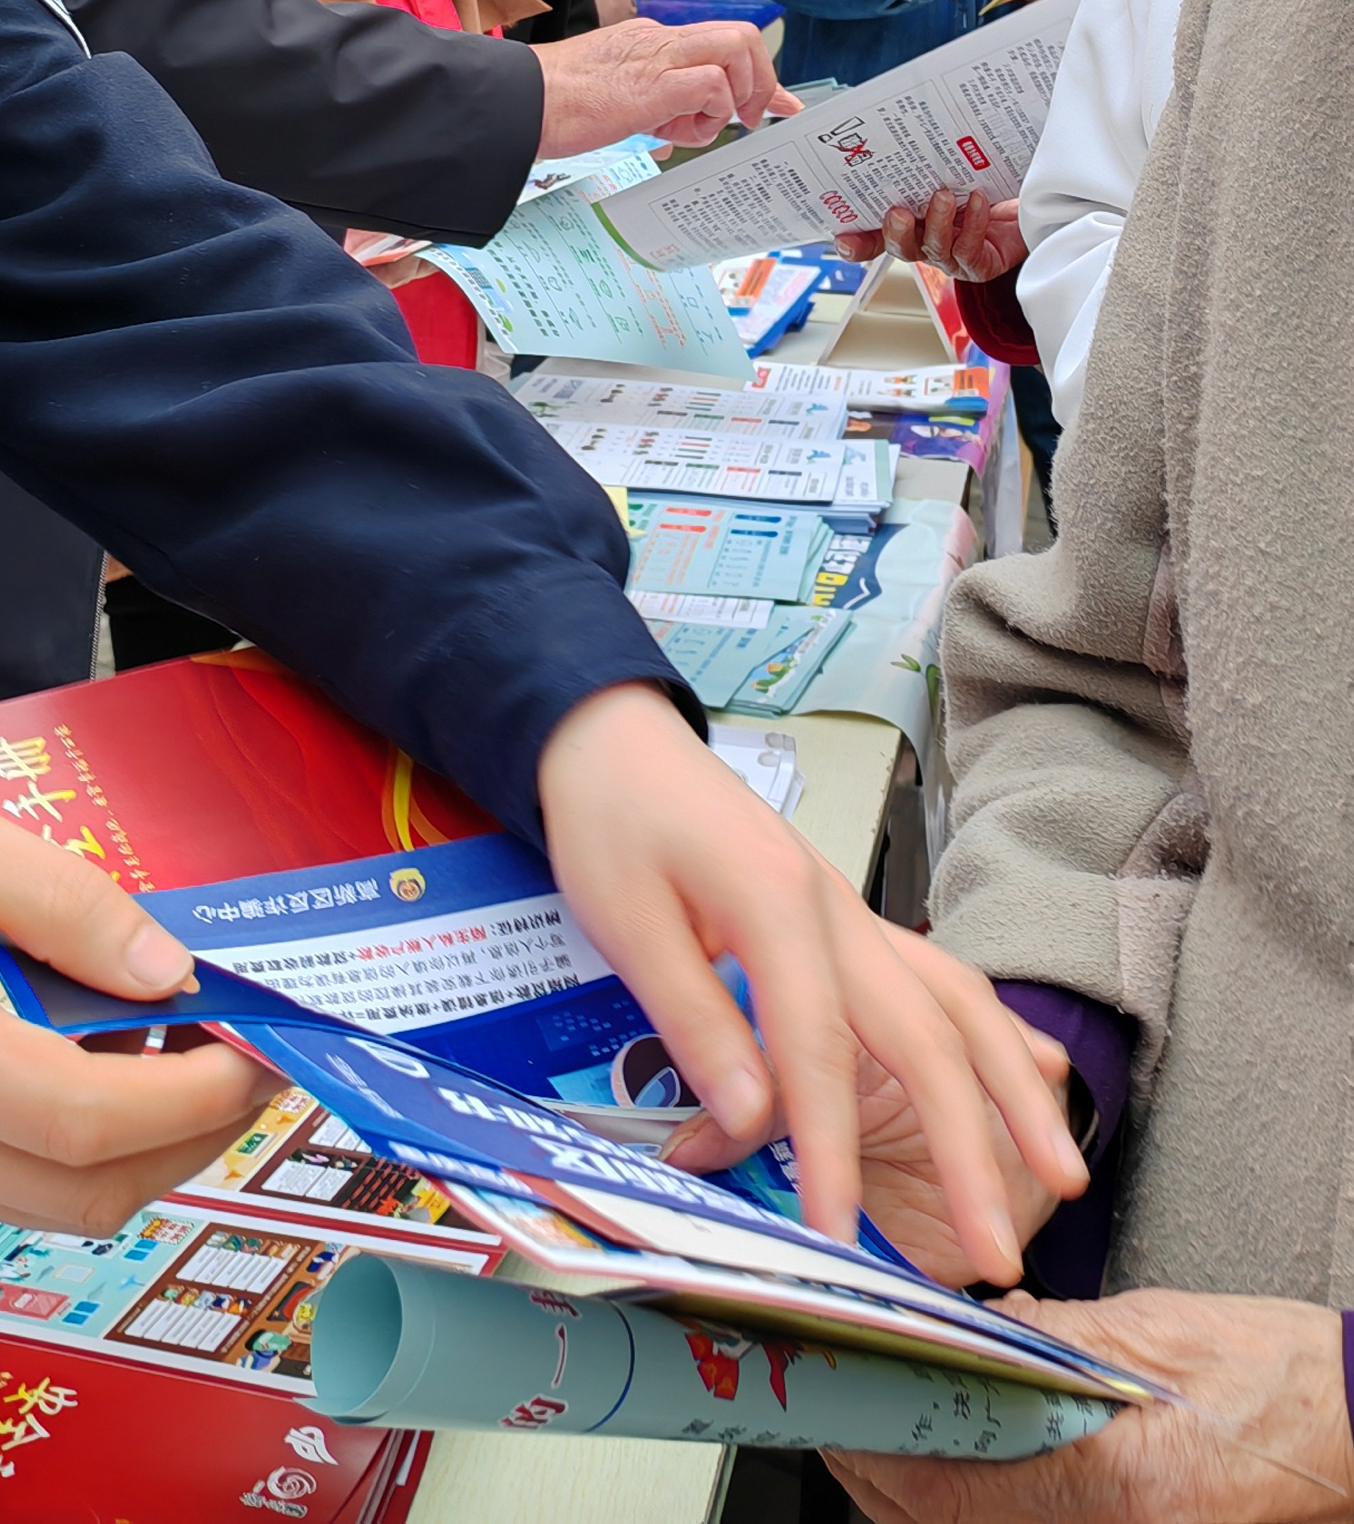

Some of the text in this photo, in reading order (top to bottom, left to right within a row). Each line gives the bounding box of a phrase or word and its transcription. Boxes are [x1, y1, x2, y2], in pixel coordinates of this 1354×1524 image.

[193, 877, 381, 924] 高新区反诈骗中心
